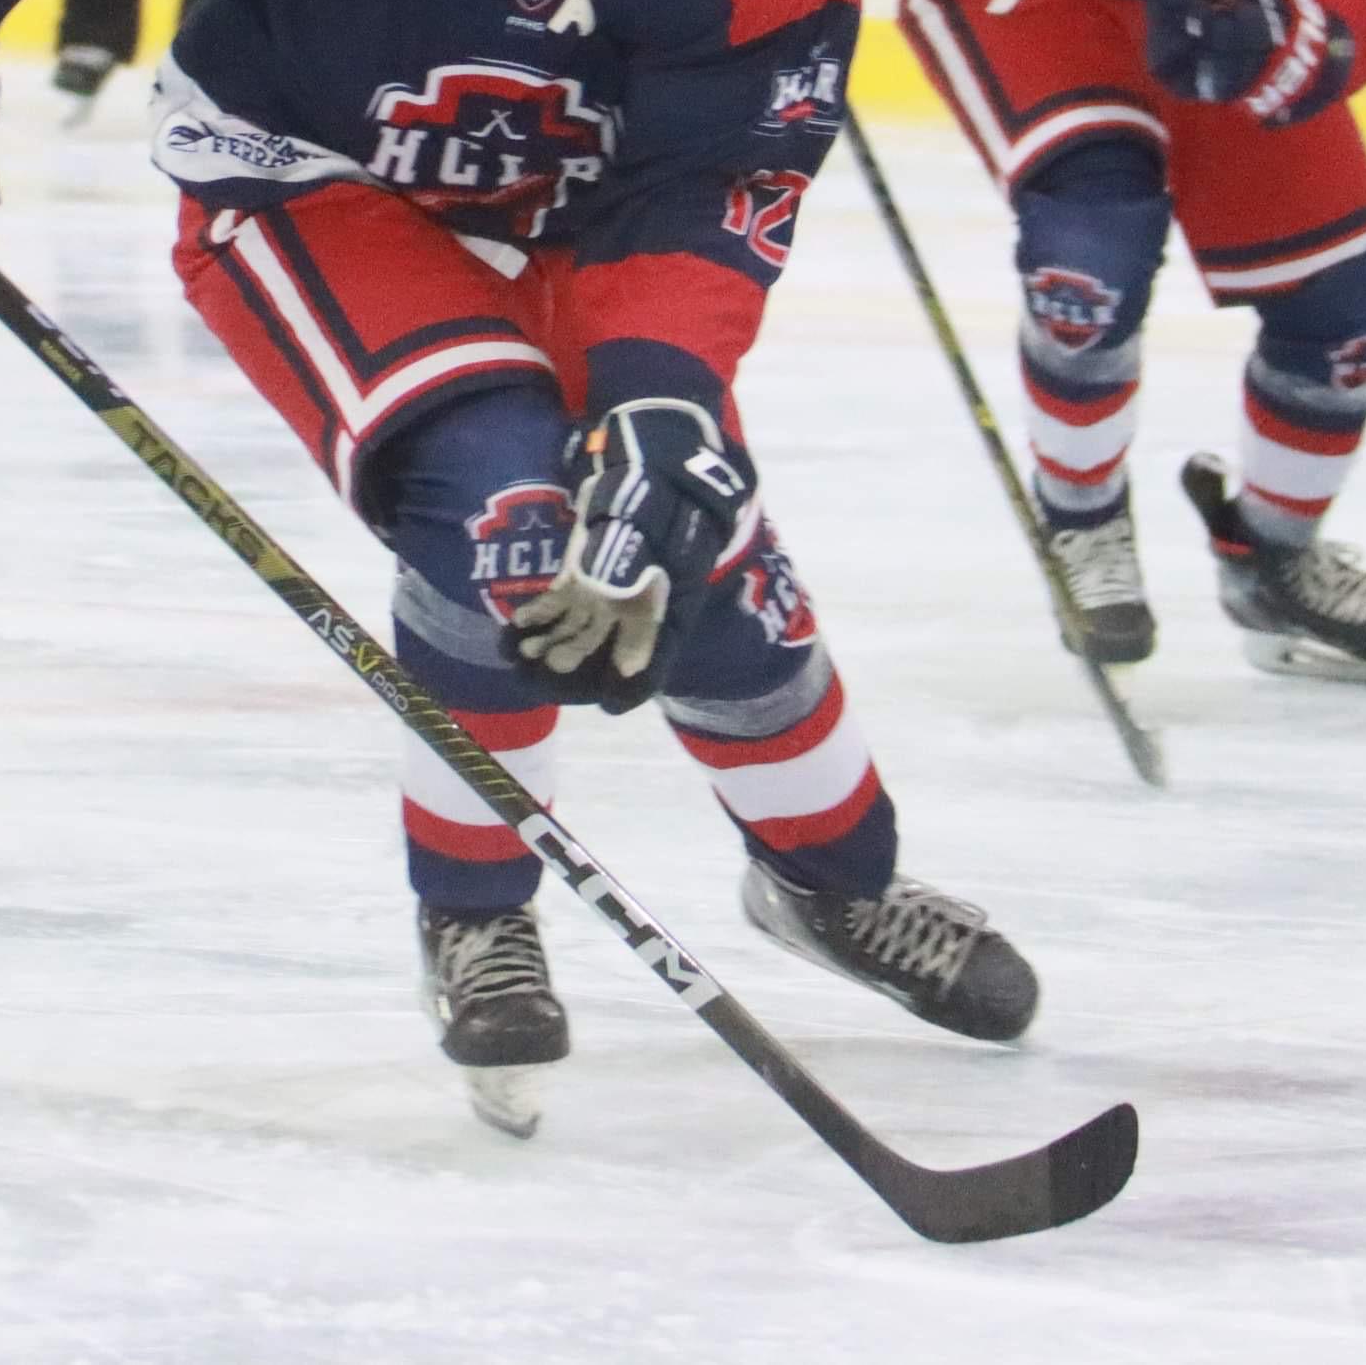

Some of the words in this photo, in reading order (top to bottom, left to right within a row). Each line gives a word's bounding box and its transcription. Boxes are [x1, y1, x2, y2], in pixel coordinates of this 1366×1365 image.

[721, 168, 812, 269] 12
[130, 418, 267, 570] TACKS
[470, 538, 567, 581] HCL
[369, 671, 409, 713] PRO
[516, 812, 723, 1013] CCM
